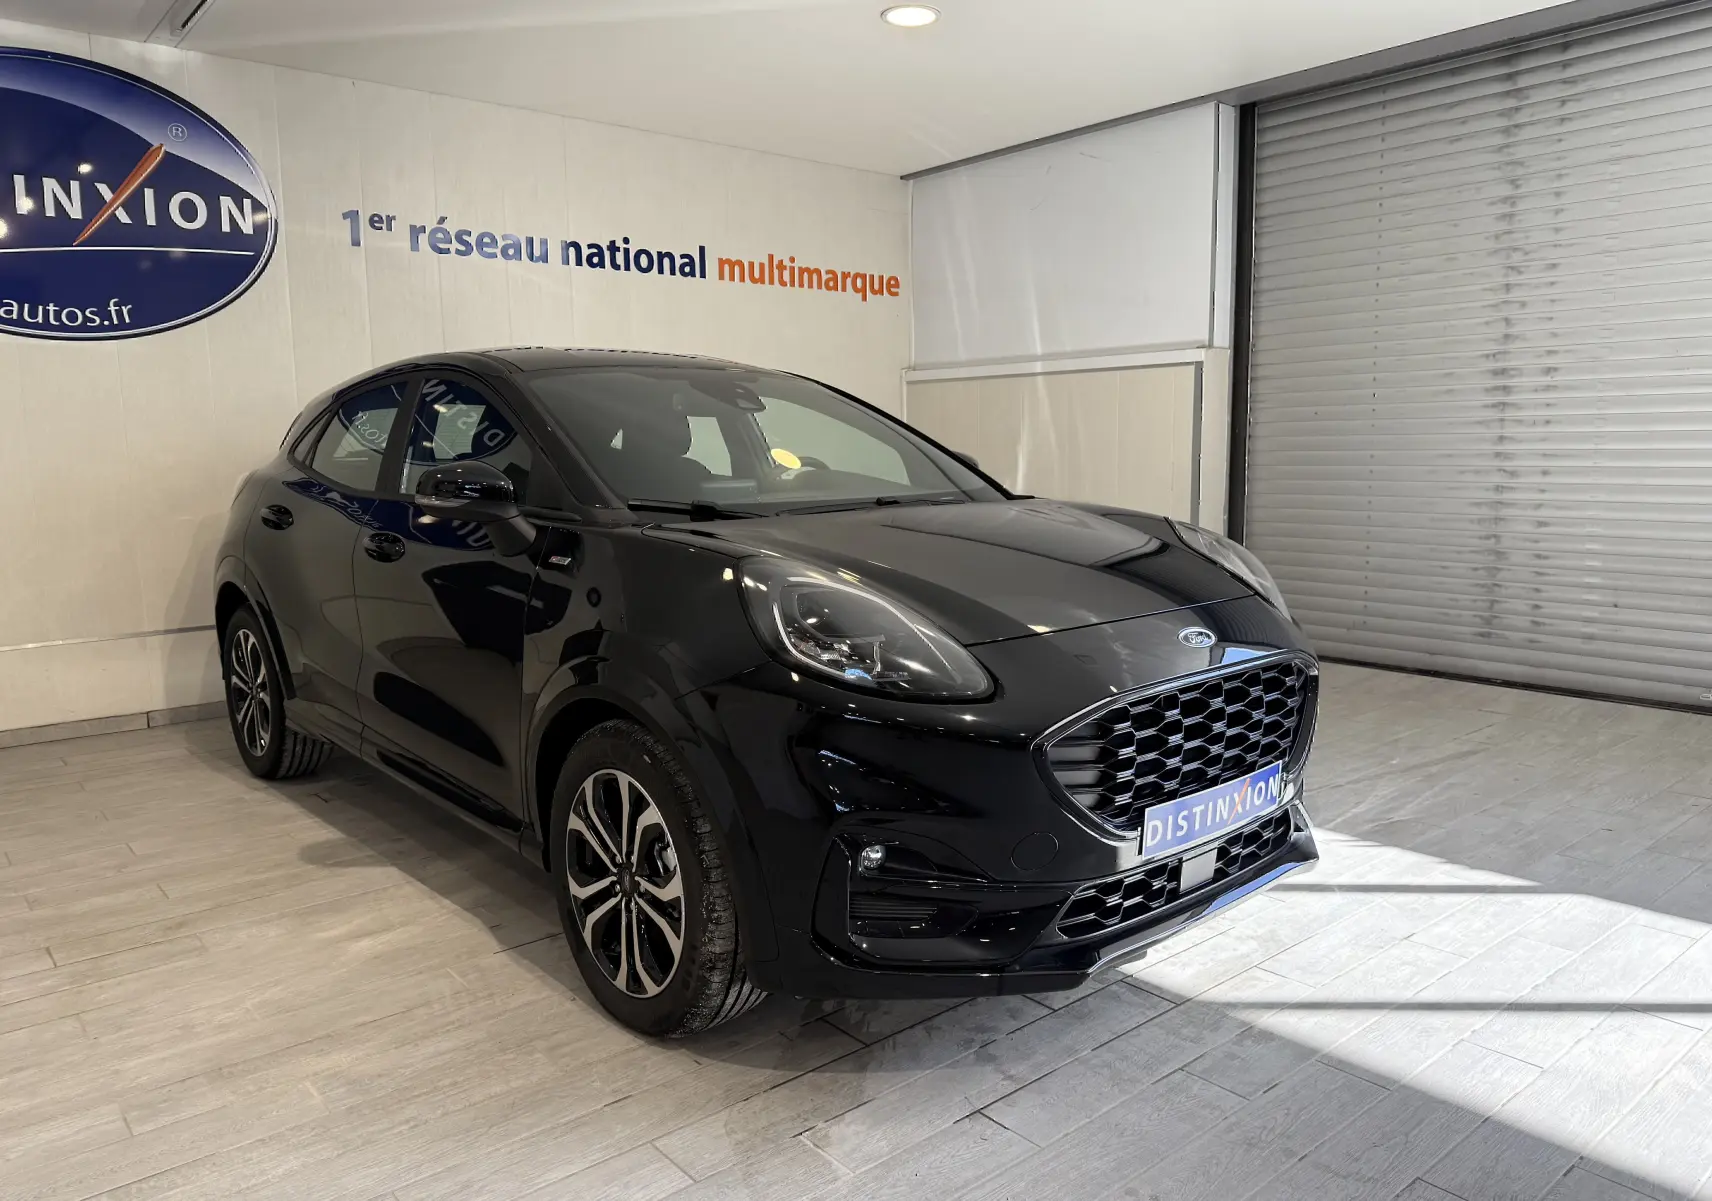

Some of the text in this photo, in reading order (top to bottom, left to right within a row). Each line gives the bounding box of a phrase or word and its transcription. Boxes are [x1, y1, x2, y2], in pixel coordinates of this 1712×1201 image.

[342, 199, 900, 302] 1er réseau national multimarque
[0, 298, 132, 326] autos.fr
[1146, 774, 1280, 848] DISTINXION
